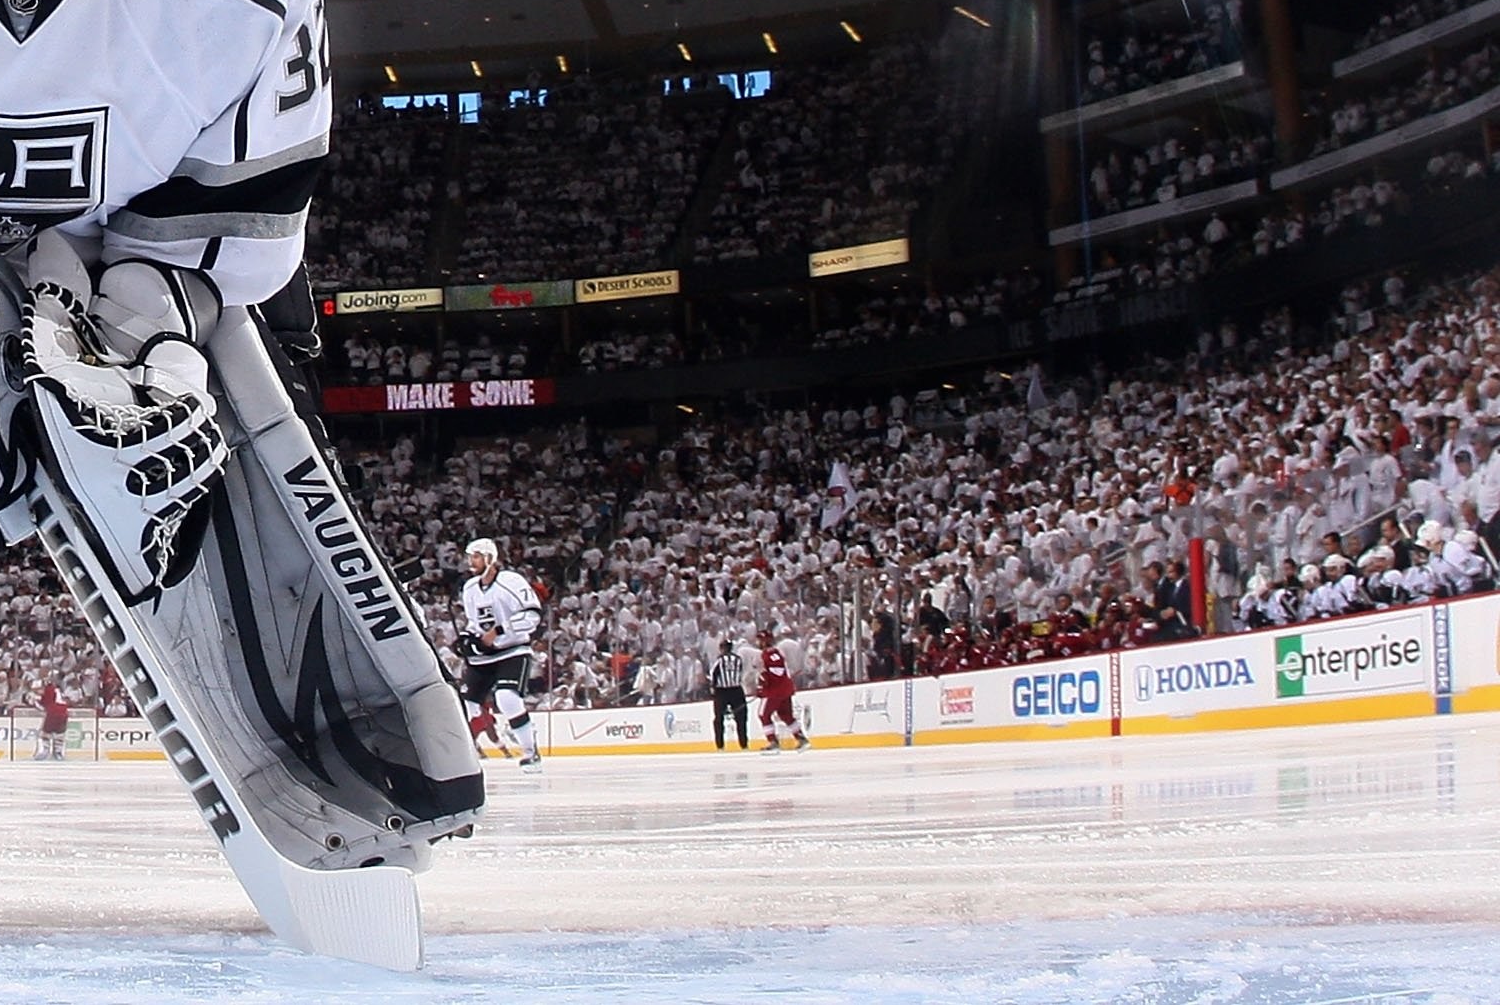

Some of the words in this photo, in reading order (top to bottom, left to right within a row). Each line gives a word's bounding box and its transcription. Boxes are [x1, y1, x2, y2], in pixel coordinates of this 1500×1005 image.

[811, 255, 853, 270] SHARP
[598, 279, 630, 293] DESERT
[632, 274, 673, 288] SCHOOLS
[343, 292, 427, 309] Jobing.com
[386, 382, 455, 411] MAKE
[470, 379, 535, 406] SOME
[283, 456, 410, 641] VAUGHN
[1283, 634, 1422, 682] enterprise
[1155, 657, 1256, 696] HONDA
[1013, 670, 1100, 717] GEICO
[606, 721, 643, 740] verizon
